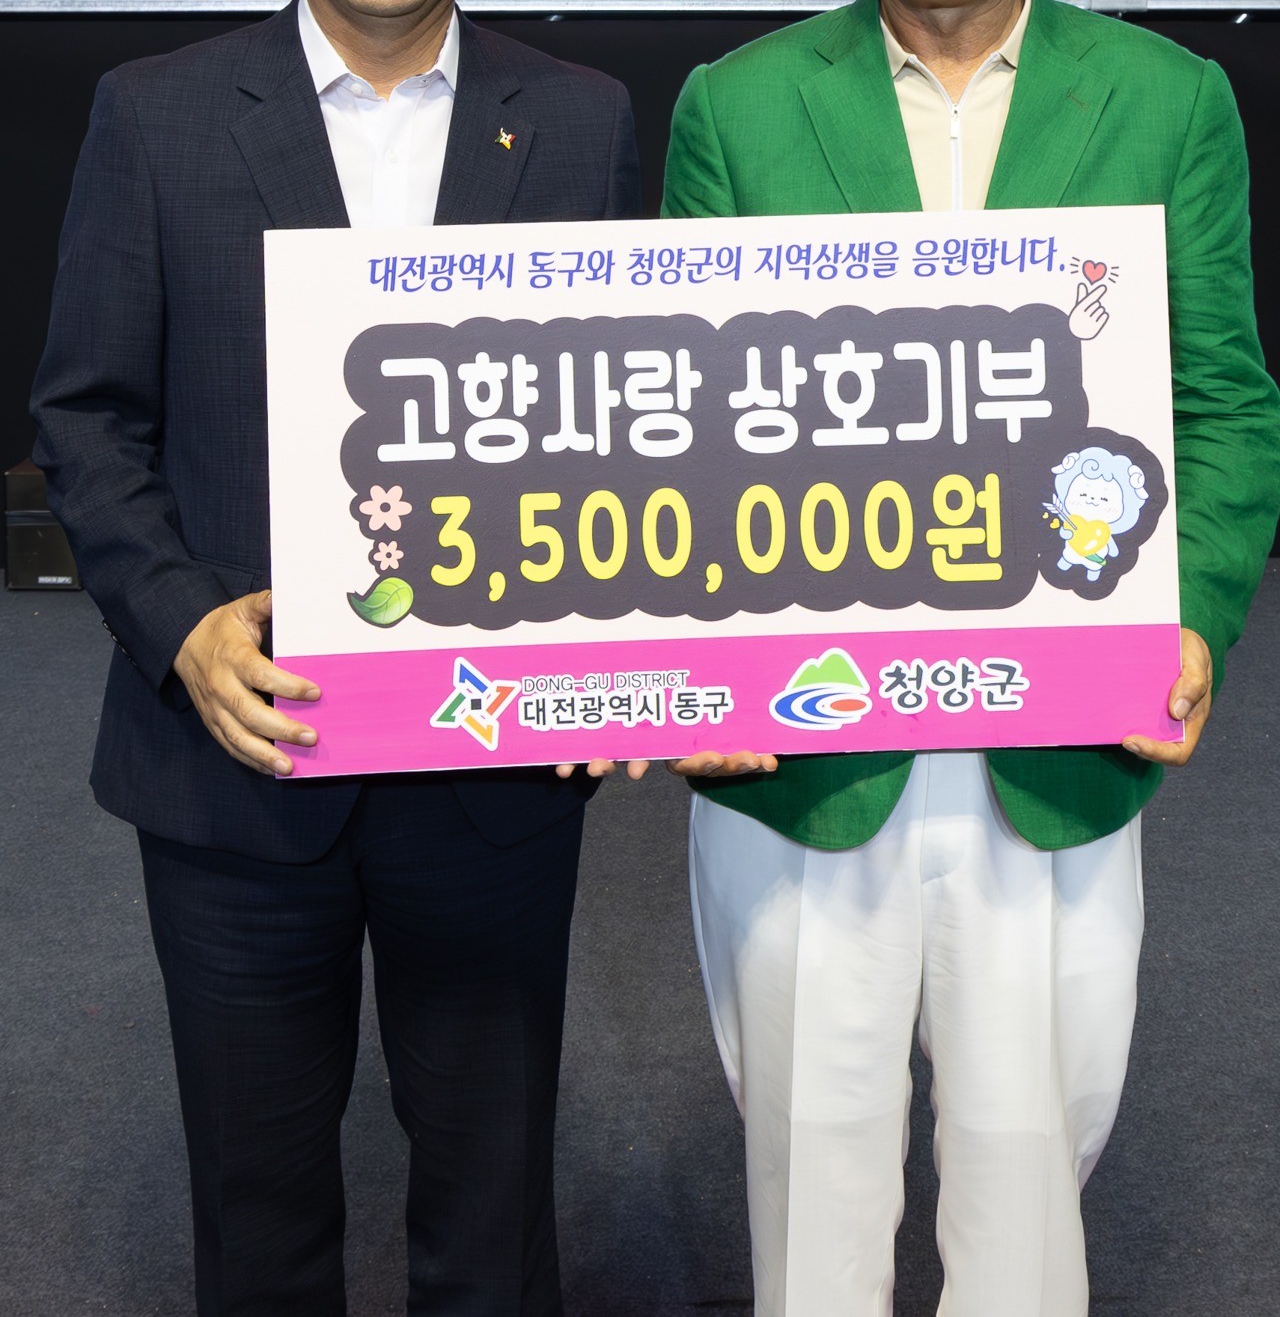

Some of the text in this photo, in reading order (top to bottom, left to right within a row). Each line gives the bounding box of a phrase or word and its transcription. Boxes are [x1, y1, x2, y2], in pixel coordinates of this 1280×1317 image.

[368, 236, 1066, 293] 대전광역시 동구와 청양군의 지역상생을 응원합니다.
[376, 337, 1053, 464] 고향사랑 상호기부
[430, 473, 1003, 602] 3,500,000원
[523, 691, 729, 726] 대전광역시 동구
[524, 672, 688, 693] DONG-GU DISTRICT
[884, 662, 1025, 709] 청양군
